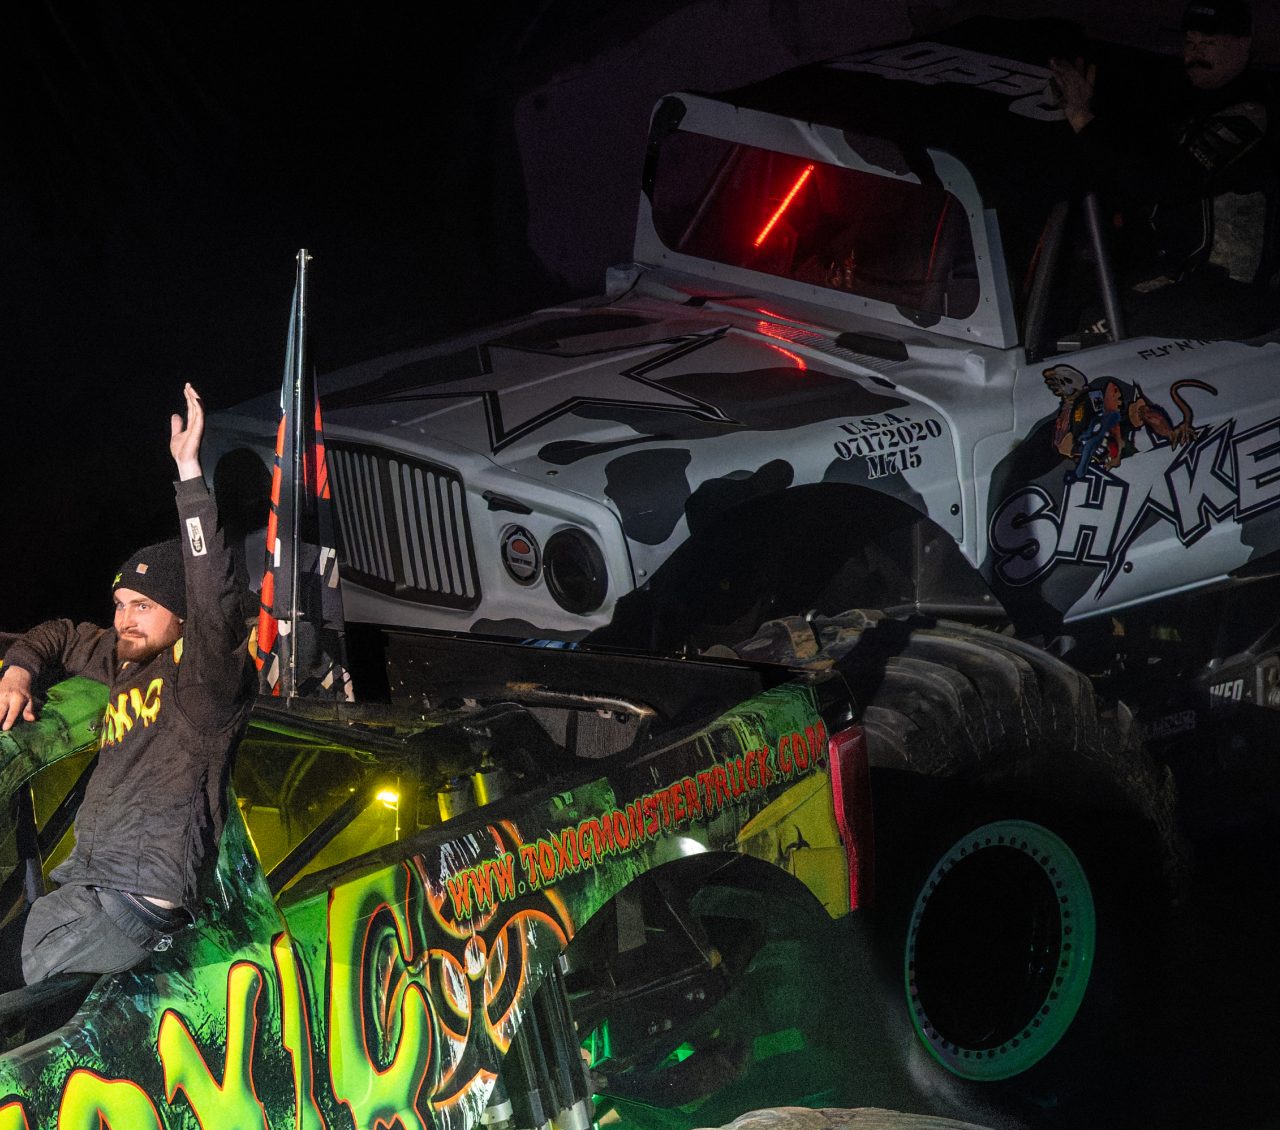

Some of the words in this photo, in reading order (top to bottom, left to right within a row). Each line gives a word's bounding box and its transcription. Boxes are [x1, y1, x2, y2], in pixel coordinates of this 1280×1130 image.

[833, 419, 942, 460] 07172020
[838, 413, 911, 435] U.S.A.
[865, 445, 923, 479] M715
